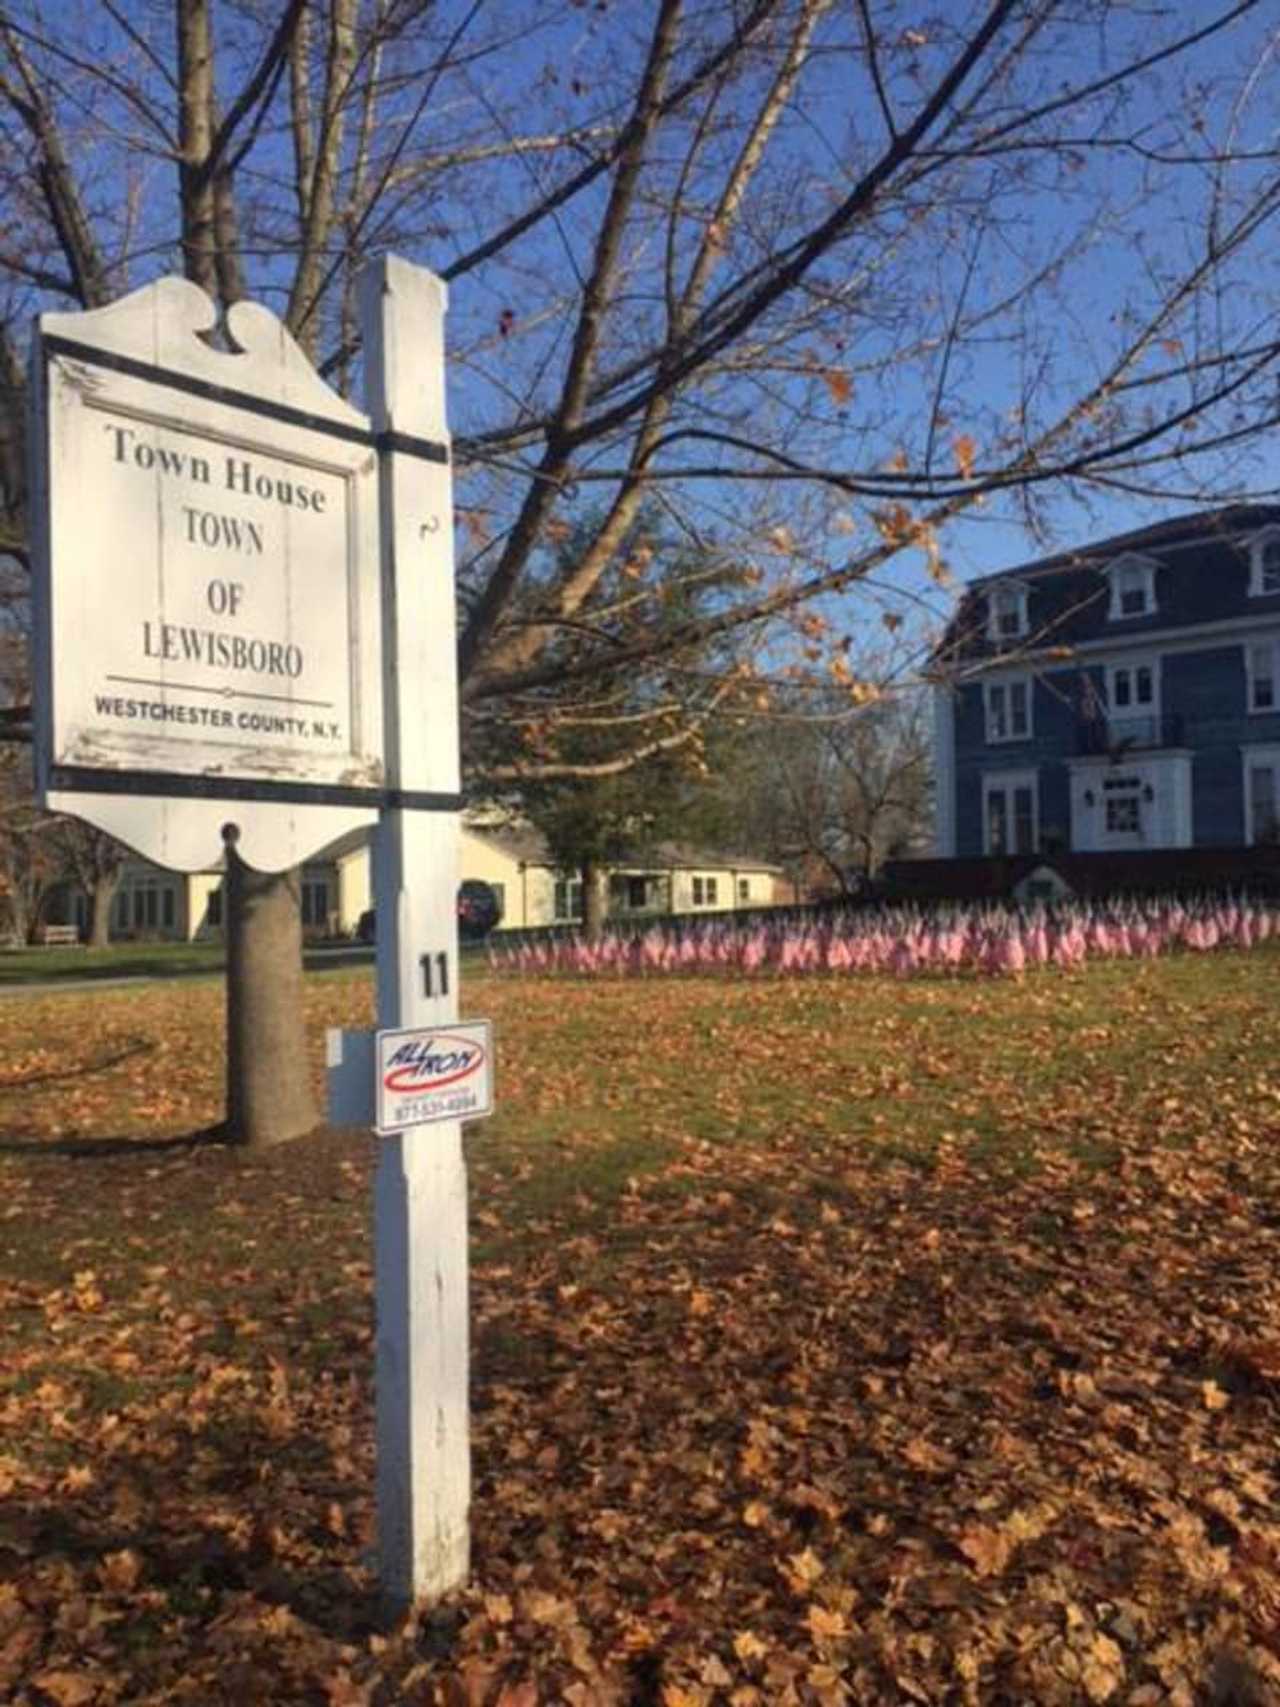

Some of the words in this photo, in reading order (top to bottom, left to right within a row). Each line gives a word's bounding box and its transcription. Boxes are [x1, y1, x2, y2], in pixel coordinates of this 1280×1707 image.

[105, 424, 210, 484] Town
[225, 456, 327, 513] House
[182, 505, 263, 555] TOWN
[207, 579, 243, 617] OF
[143, 621, 304, 679] LEWISBORO
[95, 695, 233, 729] WESTCHESTER
[237, 712, 310, 738] COUNTY,
[313, 722, 342, 740] N.Y.
[419, 951, 449, 998] 11
